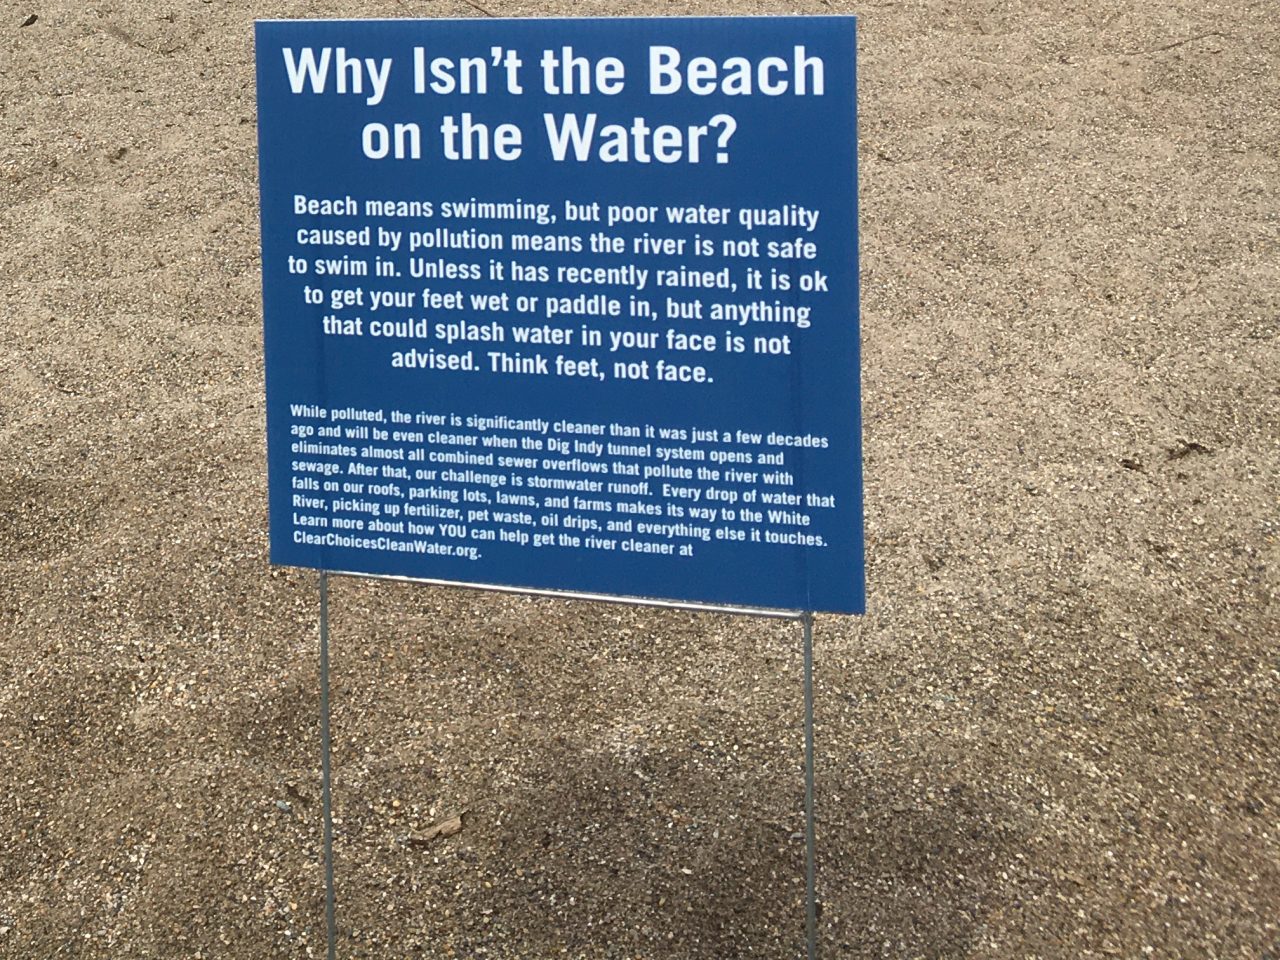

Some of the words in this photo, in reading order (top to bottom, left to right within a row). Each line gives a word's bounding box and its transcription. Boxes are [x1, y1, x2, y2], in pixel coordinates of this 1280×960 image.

[281, 46, 393, 106] Why
[413, 45, 523, 95] Isn't
[539, 45, 625, 95] the
[648, 44, 825, 96] Beach
[361, 122, 421, 160] on
[439, 111, 522, 161] the
[542, 112, 737, 164] Water?
[293, 194, 358, 216] Beach
[365, 200, 434, 218] means
[440, 197, 557, 225] swimming,
[564, 199, 601, 222] but
[607, 205, 659, 227] poor
[665, 203, 731, 225] water
[738, 203, 820, 232] quality
[296, 225, 370, 246] caused
[377, 226, 402, 252] by
[409, 227, 503, 252] pollution
[510, 233, 583, 252] means
[589, 231, 625, 254] the
[633, 232, 686, 255] river
[694, 233, 714, 256] is
[722, 237, 760, 258] not
[766, 236, 817, 260] safe
[287, 254, 308, 274] to
[314, 254, 368, 276] swim
[375, 255, 401, 277] in.
[409, 257, 482, 280] Unless
[489, 258, 504, 281] it
[510, 260, 550, 282] has
[557, 264, 649, 291] recently
[656, 264, 737, 293] rained,
[746, 266, 763, 290] it
[770, 267, 791, 291] is
[799, 269, 829, 292] ok
[303, 285, 324, 304] to
[330, 286, 364, 310] get
[369, 290, 416, 311] your
[421, 287, 464, 310] feet
[469, 292, 509, 312] wet
[515, 295, 539, 313] or
[545, 293, 621, 318] paddle
[629, 294, 658, 321] in,
[666, 296, 703, 320] but
[709, 299, 811, 329] anything
[322, 314, 363, 336] that
[369, 317, 427, 339] could
[434, 319, 505, 344] splash
[511, 324, 574, 345] water
[581, 324, 602, 346] in
[609, 330, 659, 352] your
[665, 328, 716, 352] face
[725, 330, 745, 353] is
[753, 334, 791, 355] not
[391, 347, 480, 371] advised.
[486, 351, 549, 375] Think
[554, 354, 605, 381] feet,
[613, 360, 650, 380] not
[655, 359, 714, 383] face.
[289, 403, 327, 419] While
[330, 406, 387, 424] polluted,
[390, 409, 412, 424] the
[415, 410, 446, 426] river
[450, 412, 462, 427] is
[465, 413, 549, 435] significantly
[552, 419, 606, 435] cleaner
[609, 422, 641, 437] than
[644, 423, 655, 439] it
[658, 427, 688, 441] was
[690, 426, 719, 444] just
[722, 431, 732, 443] a
[735, 429, 763, 444] few
[766, 431, 829, 449] decades
[290, 440, 358, 457] eliminates
[360, 444, 405, 460] almost
[407, 447, 425, 461] all
[428, 450, 494, 466] combined
[497, 455, 539, 469] sewer
[541, 457, 609, 474] overflows
[612, 460, 640, 476] that
[643, 463, 693, 480] pollute
[696, 466, 720, 481] the
[724, 467, 759, 484] river
[762, 470, 794, 486] with
[291, 460, 344, 476] sewage.
[347, 461, 379, 476] After
[381, 464, 411, 481] that,
[414, 468, 437, 480] our
[440, 468, 507, 488] challenge
[510, 472, 523, 487] is
[526, 474, 603, 492] stormwater
[607, 481, 653, 496] runoff.
[662, 482, 702, 502] Every
[705, 486, 738, 505] drop
[742, 488, 757, 503] of
[760, 491, 803, 506] water
[805, 492, 835, 508] that
[291, 475, 320, 491] falls
[322, 480, 340, 492] on
[342, 482, 364, 494] our
[367, 482, 405, 499] roofs,
[408, 485, 459, 504] parking
[462, 487, 492, 505] lots,
[495, 490, 540, 508] lawns,
[543, 495, 570, 509] and
[572, 495, 612, 512] farms
[616, 500, 663, 516] makes
[666, 502, 685, 518] its
[688, 506, 717, 523] way
[720, 507, 736, 521] to
[739, 507, 763, 523] the
[766, 509, 811, 526] White
[292, 511, 328, 528] Learn
[331, 517, 364, 530] more
[367, 518, 405, 534] about
[407, 520, 435, 536] how
[438, 523, 467, 538] YOU
[470, 528, 496, 541] can
[499, 527, 529, 546] help
[532, 532, 555, 547] get
[558, 532, 581, 548] the
[584, 534, 617, 550] river
[620, 537, 675, 555] cleaner
[678, 543, 693, 557] at
[293, 529, 482, 561] ClearChoicesCleanWater.org.
